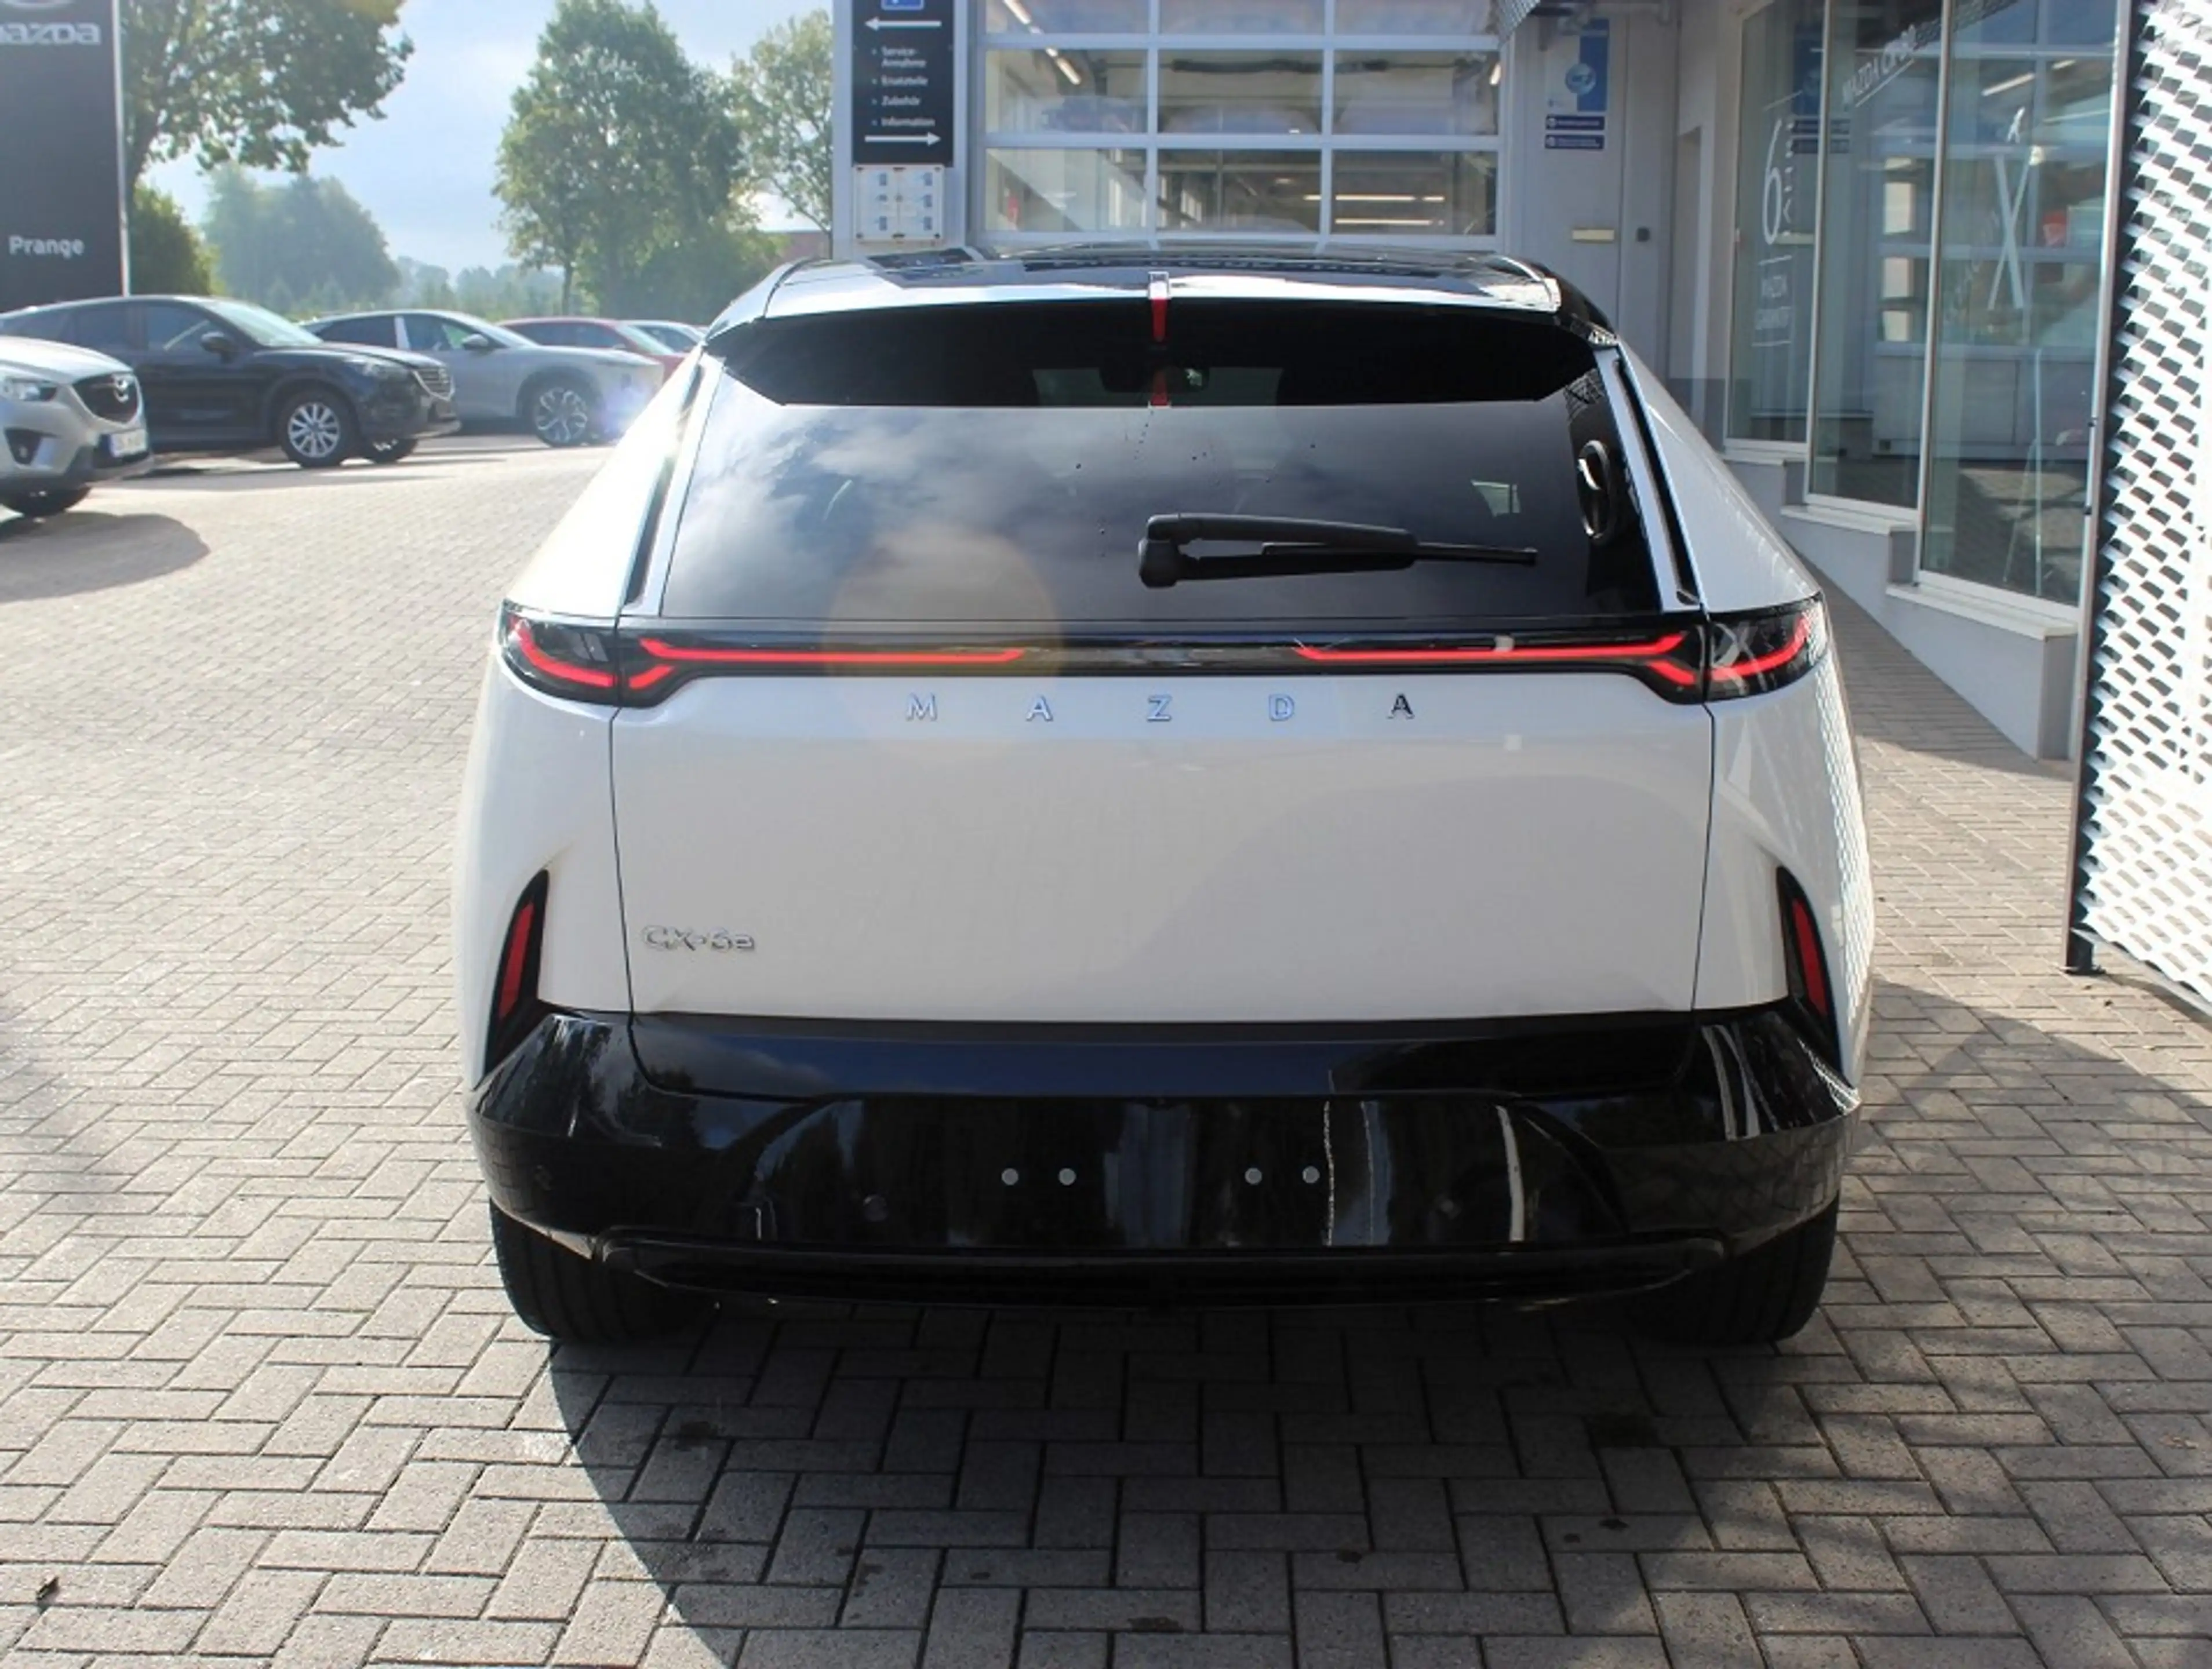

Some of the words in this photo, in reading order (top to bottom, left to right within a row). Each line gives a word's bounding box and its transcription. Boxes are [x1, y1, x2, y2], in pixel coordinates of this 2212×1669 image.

[0, 23, 101, 45] azda
[881, 116, 936, 127] Information
[9, 235, 85, 260] Prange
[905, 694, 1414, 721] MAZDA
[642, 925, 755, 952] CX-6e
